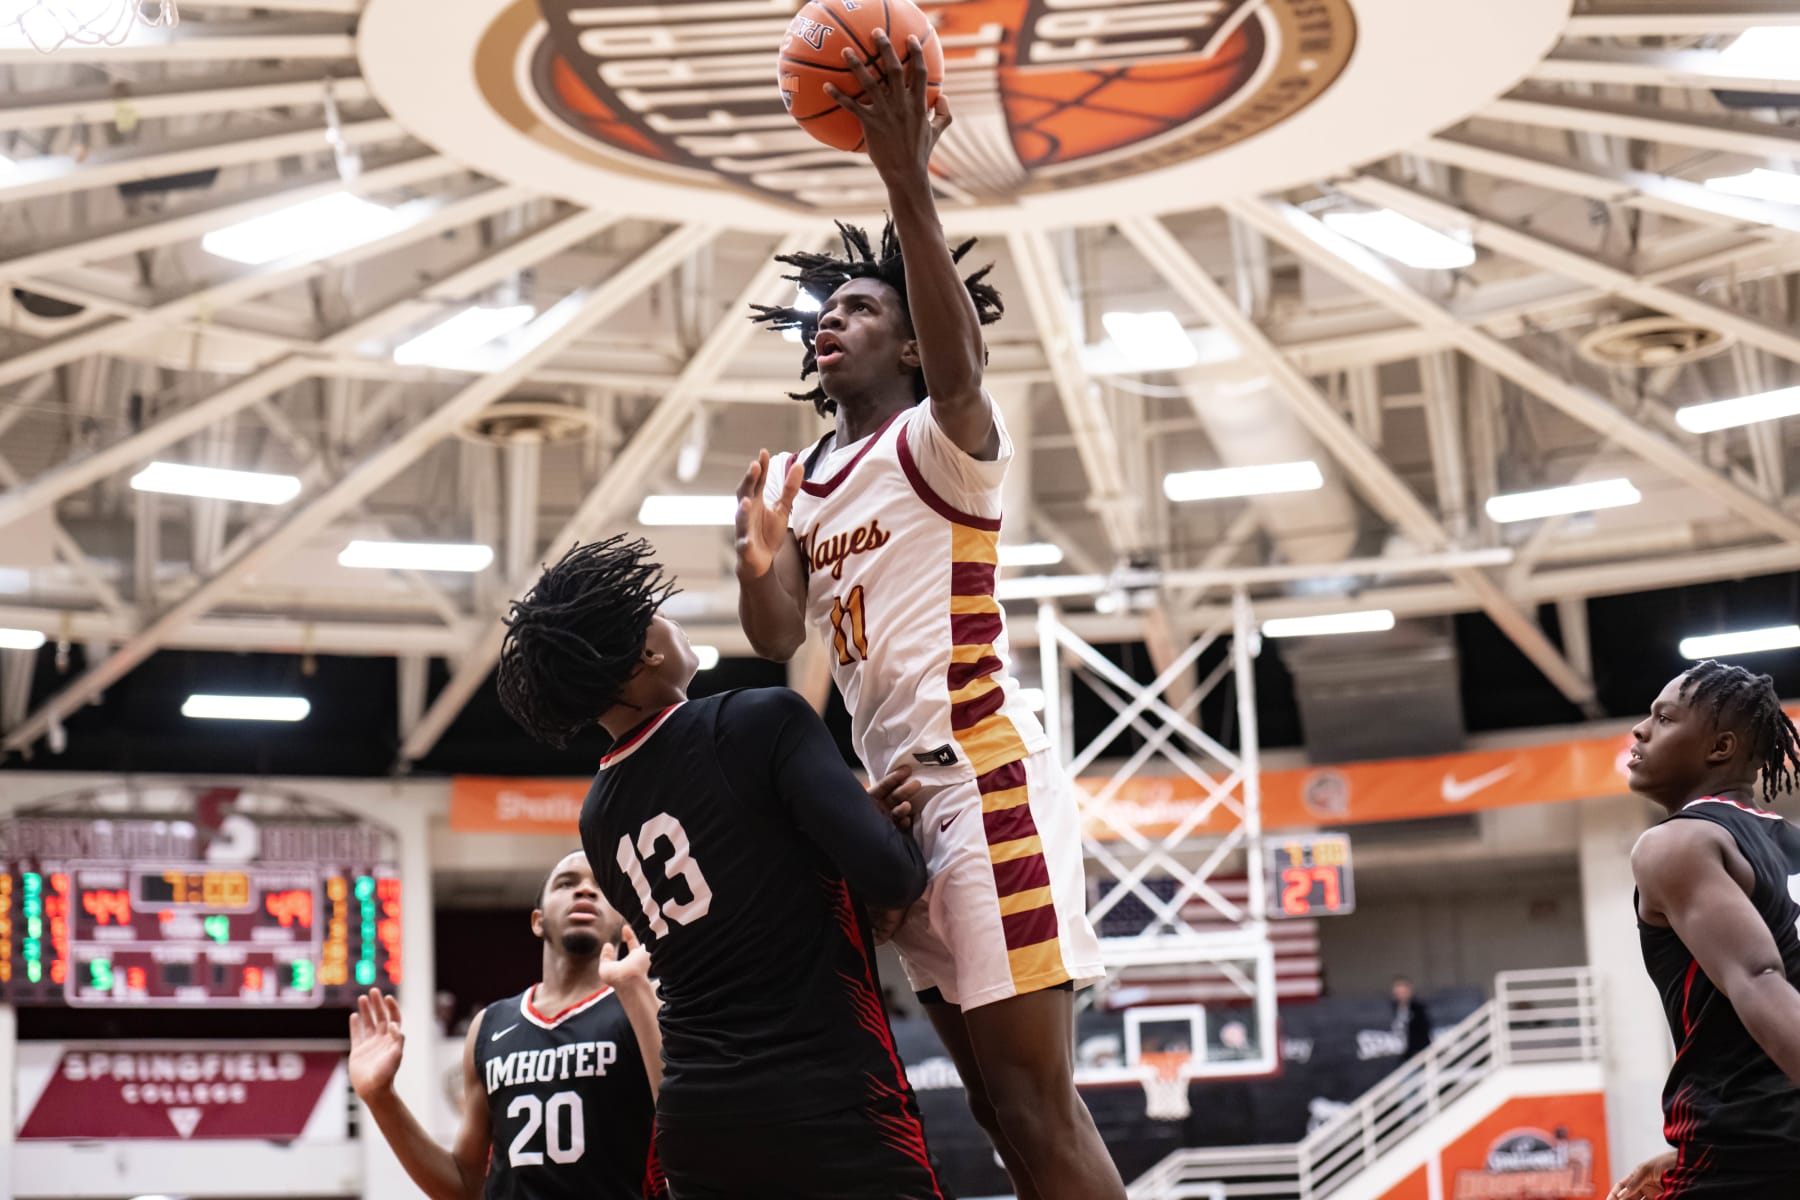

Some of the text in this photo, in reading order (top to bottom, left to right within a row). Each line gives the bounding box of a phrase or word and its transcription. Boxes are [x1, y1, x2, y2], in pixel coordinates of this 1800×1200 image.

[799, 519, 891, 580] Hayes
[829, 584, 868, 666] 11
[616, 811, 713, 940] 13
[1282, 866, 1340, 915] 27
[63, 1053, 306, 1081] SPRINGFIELD
[121, 1082, 246, 1104] COLLEGE
[485, 1041, 617, 1095] IMHOTEP
[506, 1090, 585, 1168] 20
